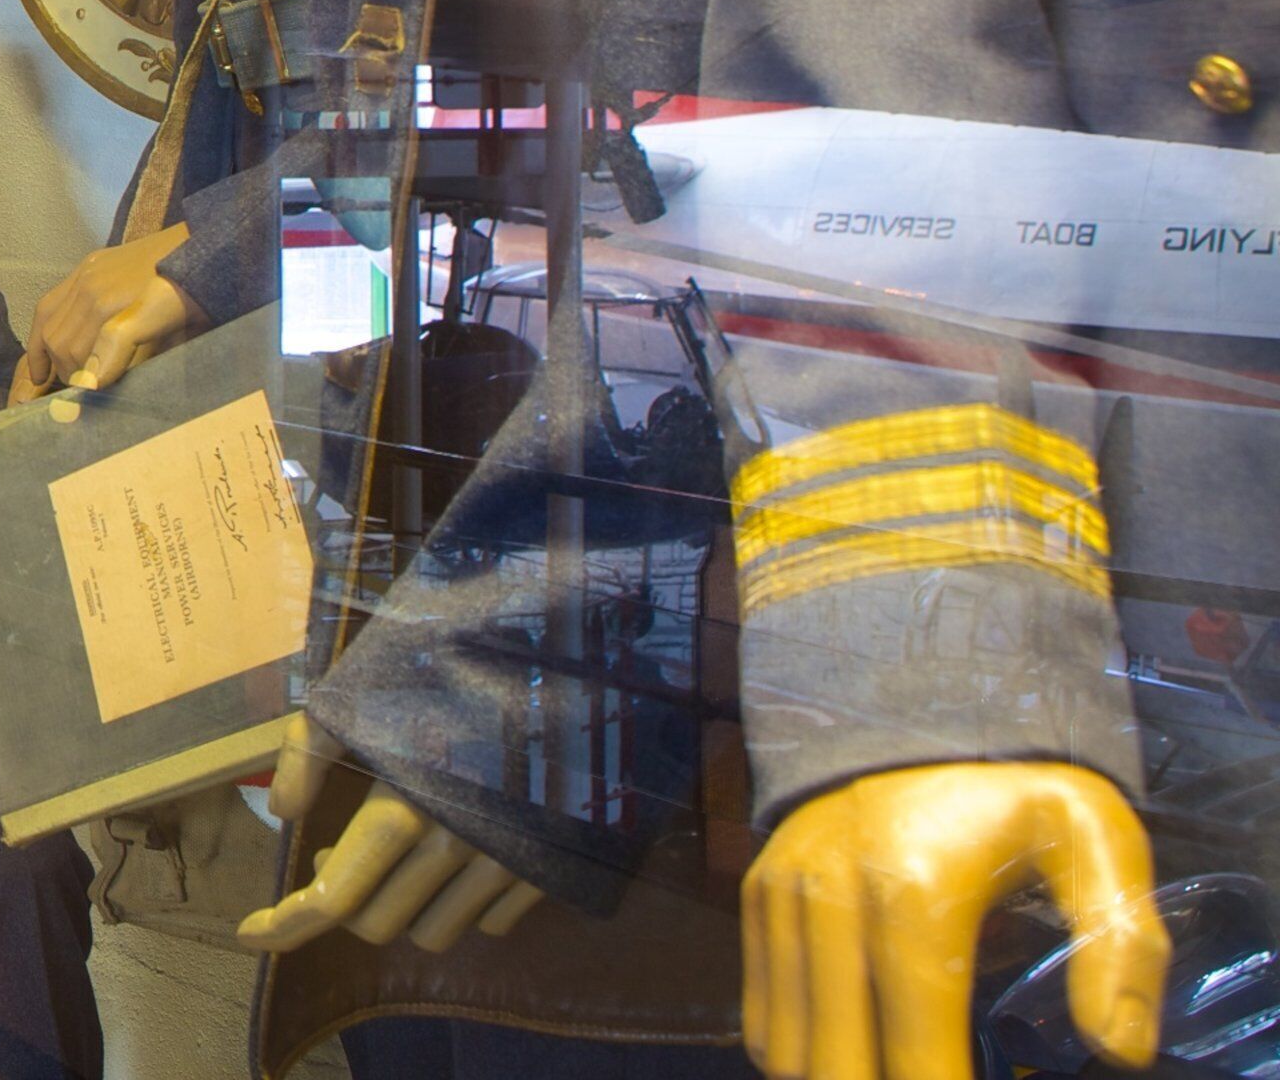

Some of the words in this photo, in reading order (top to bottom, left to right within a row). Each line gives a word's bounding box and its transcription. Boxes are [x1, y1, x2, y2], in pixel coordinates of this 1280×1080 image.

[123, 487, 151, 568] EQUIPMENT
[156, 502, 178, 568] SERVICES
[173, 517, 200, 600] (AIRBORNE)
[147, 537, 170, 599] MANUAL
[174, 573, 194, 626] POWER
[145, 572, 174, 663] ELECTRICAL
